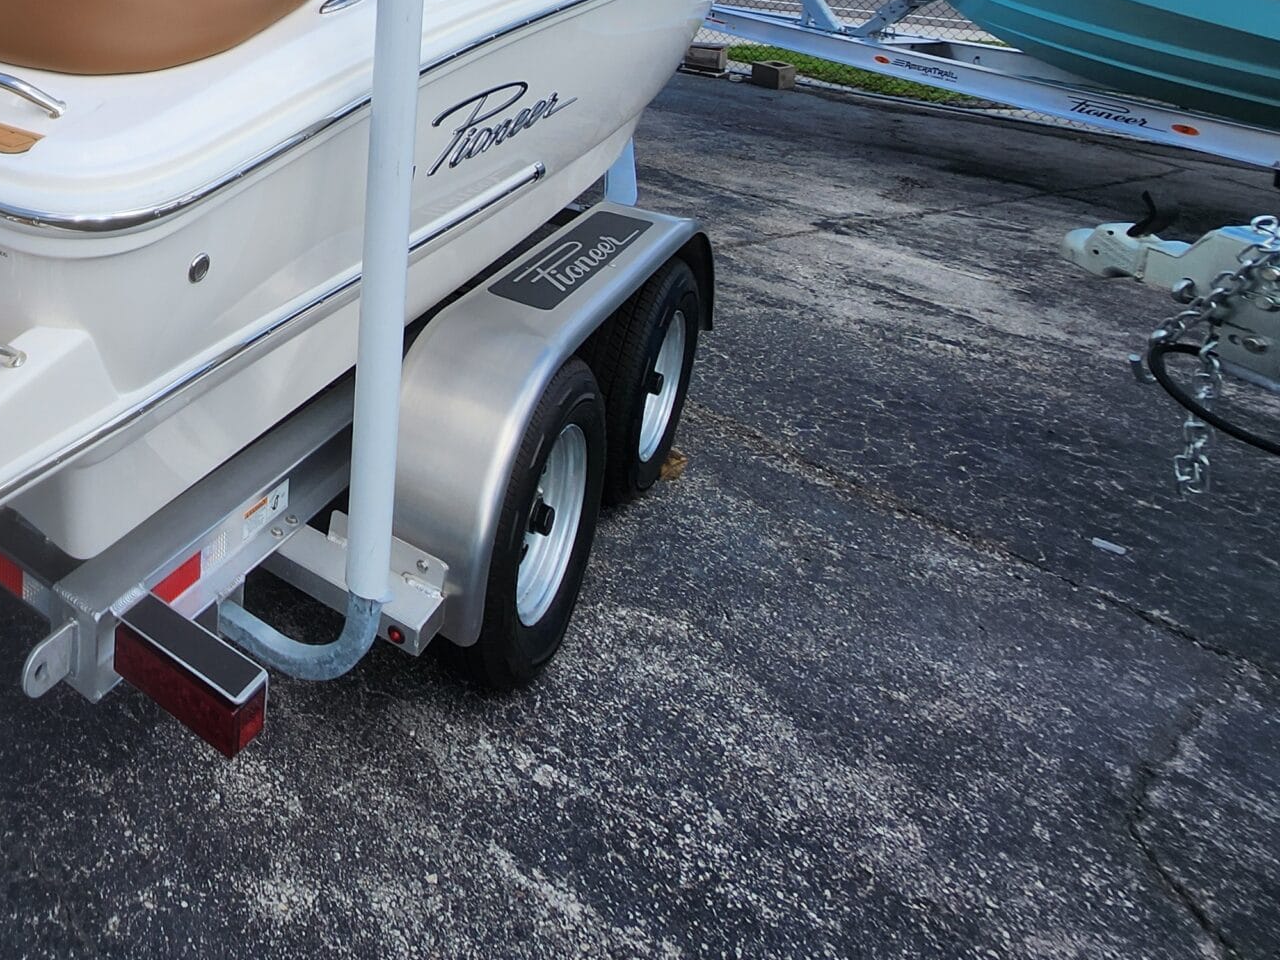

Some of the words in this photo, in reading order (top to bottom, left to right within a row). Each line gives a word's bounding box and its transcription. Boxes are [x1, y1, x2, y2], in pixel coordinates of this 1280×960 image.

[427, 81, 578, 177] Pioneer
[1067, 95, 1168, 133] Pioneer
[513, 229, 640, 292] Pioneer
